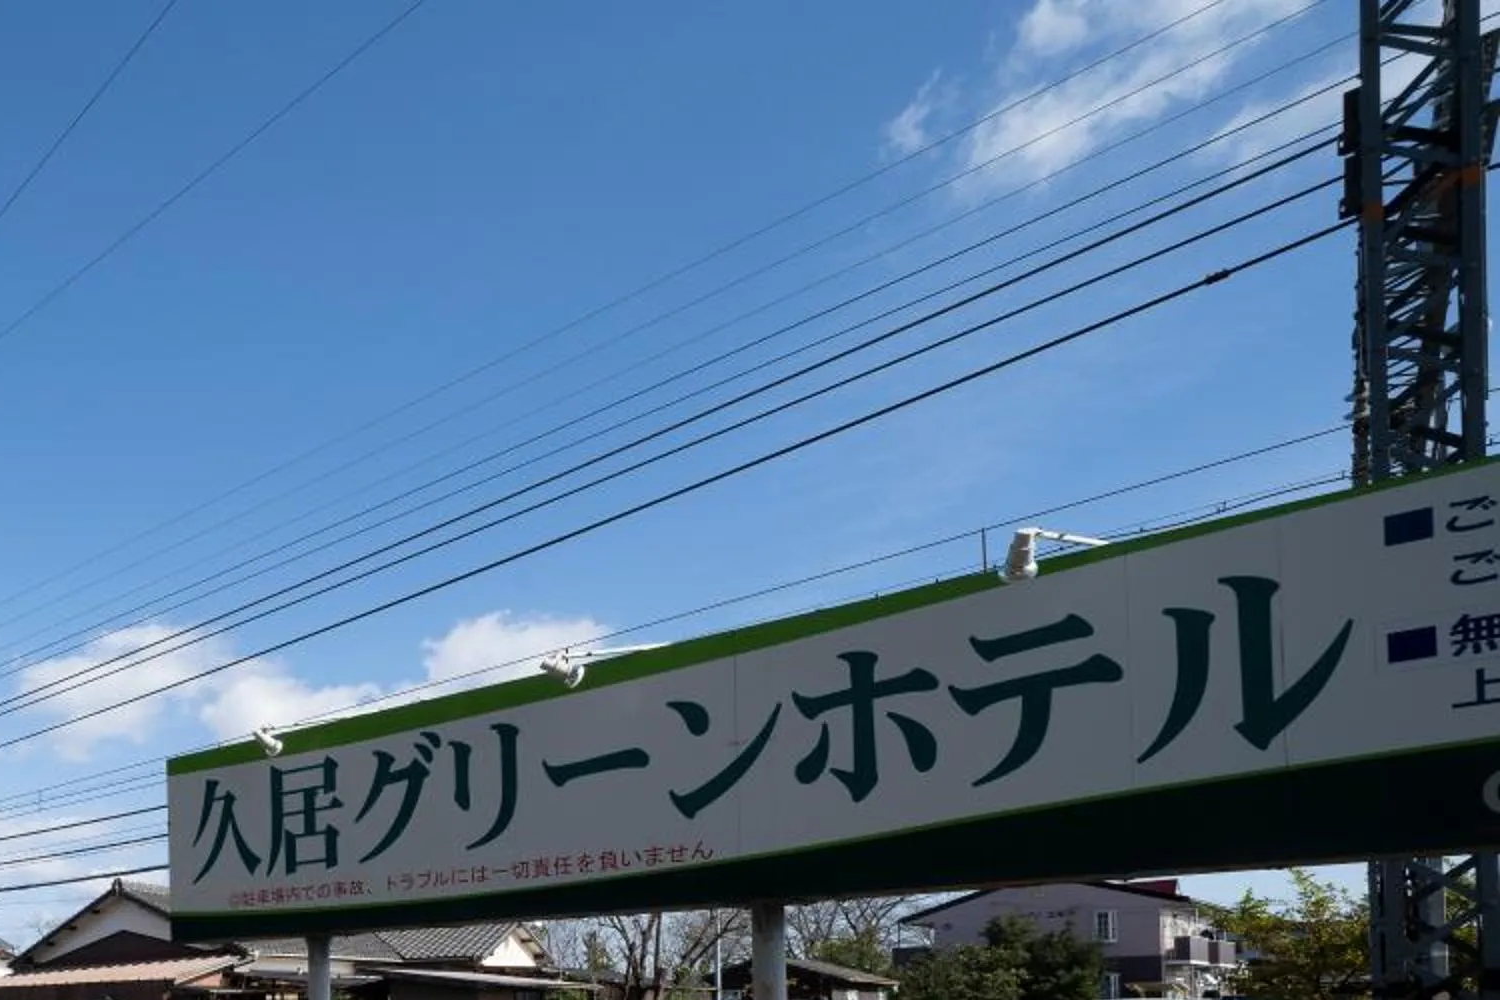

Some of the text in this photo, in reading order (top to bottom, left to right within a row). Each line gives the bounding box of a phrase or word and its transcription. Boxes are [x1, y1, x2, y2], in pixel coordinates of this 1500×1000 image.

[1445, 495, 1499, 532] ご
[1450, 549, 1500, 586] ご
[192, 575, 1354, 885] 久居グリーンホテル
